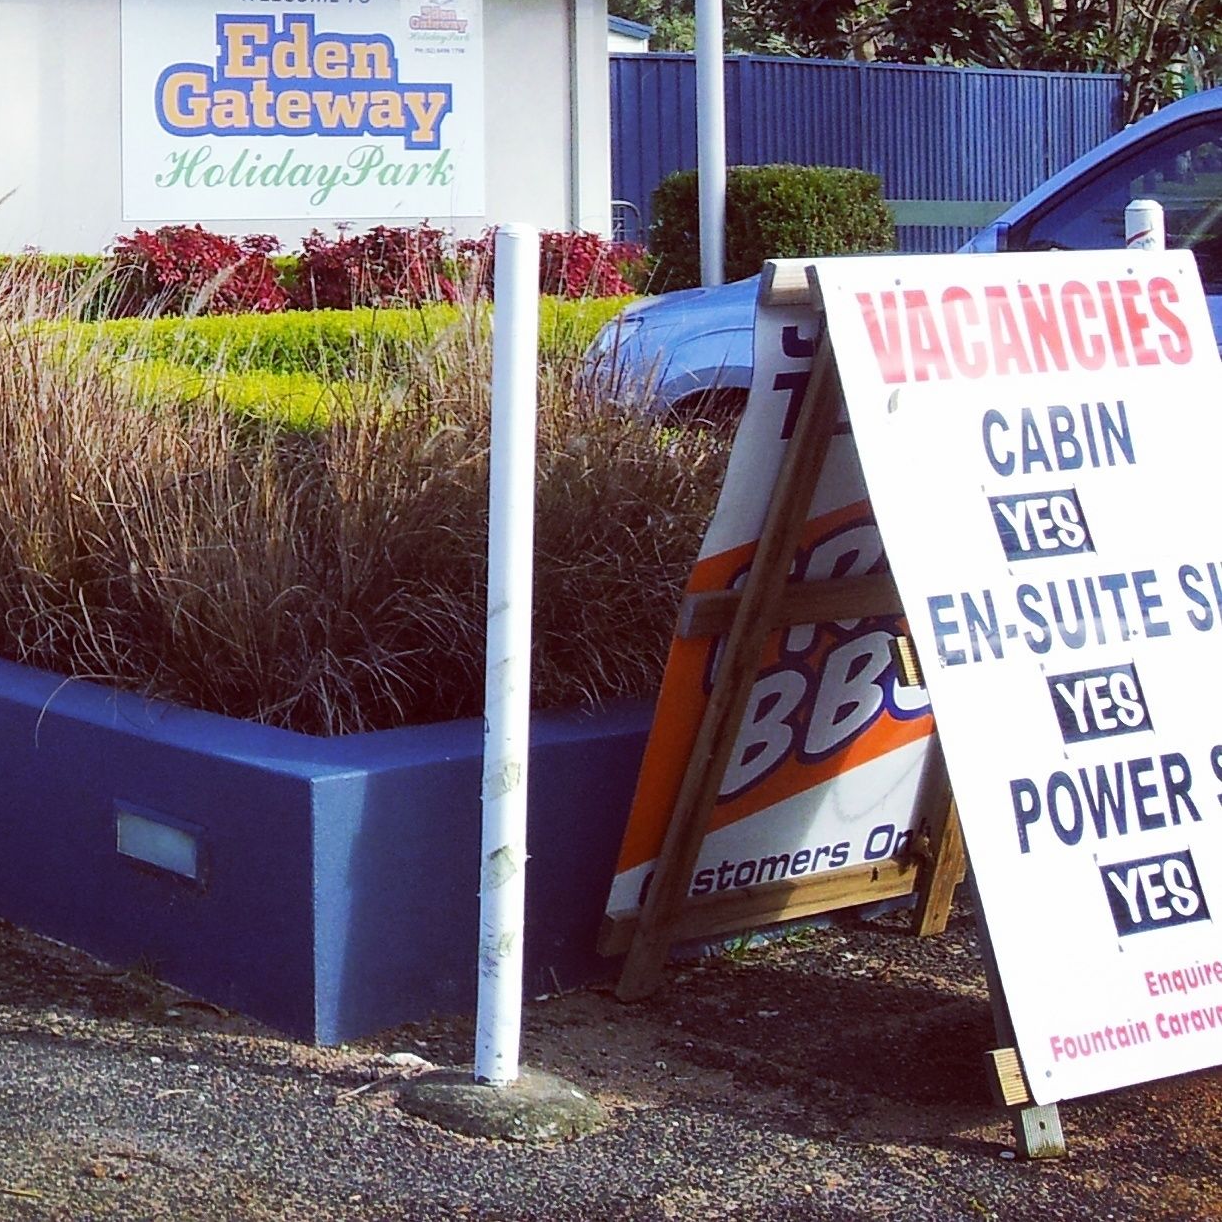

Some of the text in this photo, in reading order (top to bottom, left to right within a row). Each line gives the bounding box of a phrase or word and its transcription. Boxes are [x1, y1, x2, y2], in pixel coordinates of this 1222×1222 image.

[220, 18, 395, 80] Eden
[159, 68, 449, 145] Gateway
[855, 276, 1194, 384] VACANCIES
[981, 400, 1137, 477] CABIN
[996, 495, 1086, 552] YES
[927, 569, 1171, 667] EN-SUITE
[1056, 672, 1145, 735] YES
[1009, 752, 1203, 855] POWER
[639, 841, 851, 906] stomers
[1108, 858, 1200, 924] YES
[1050, 1018, 1152, 1063] Fountain
